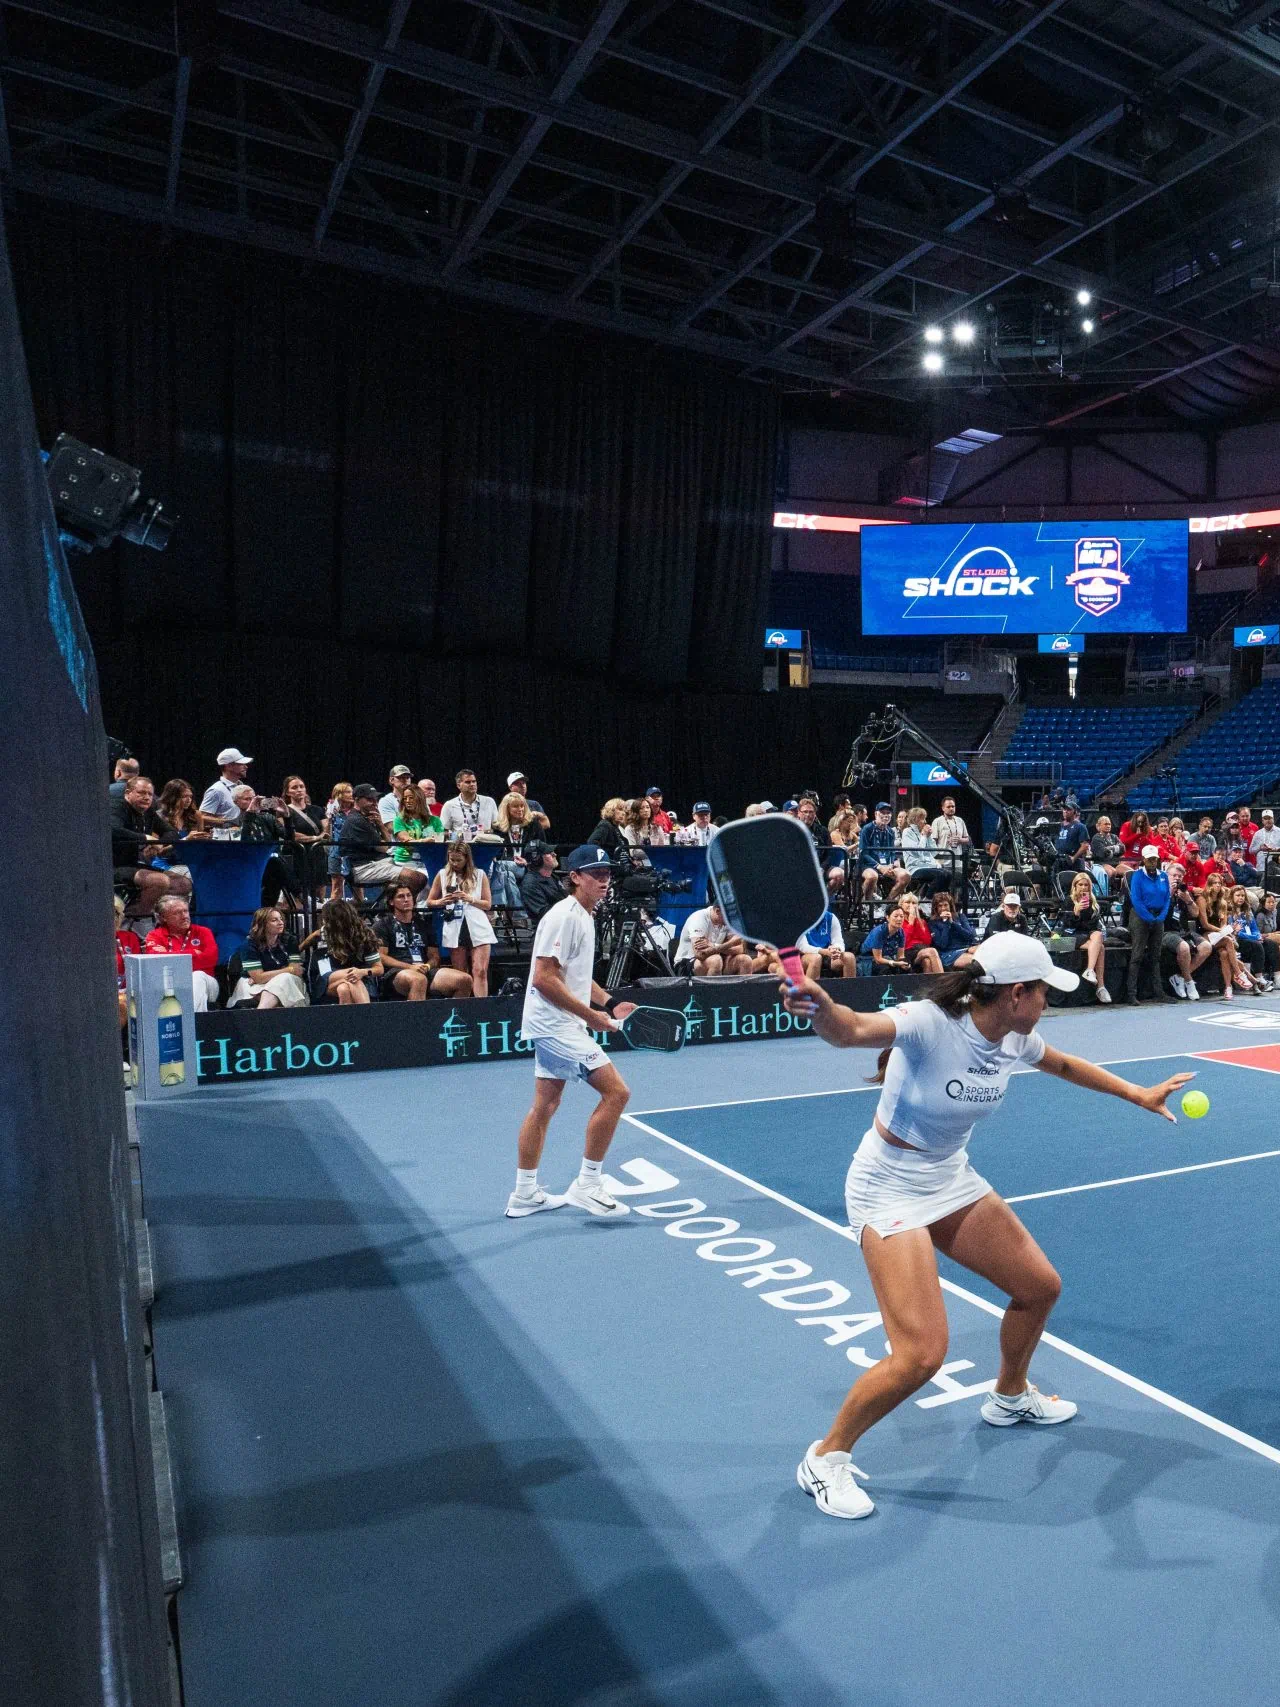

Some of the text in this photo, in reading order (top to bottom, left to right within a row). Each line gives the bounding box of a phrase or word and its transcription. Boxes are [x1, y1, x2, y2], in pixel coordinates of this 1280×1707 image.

[903, 576, 1037, 597] SHOCK
[711, 1003, 813, 1037] Harbo
[196, 1033, 360, 1077] Harbor
[967, 1066, 1000, 1075] SHOCK
[966, 1086, 1000, 1096] SPORTS
